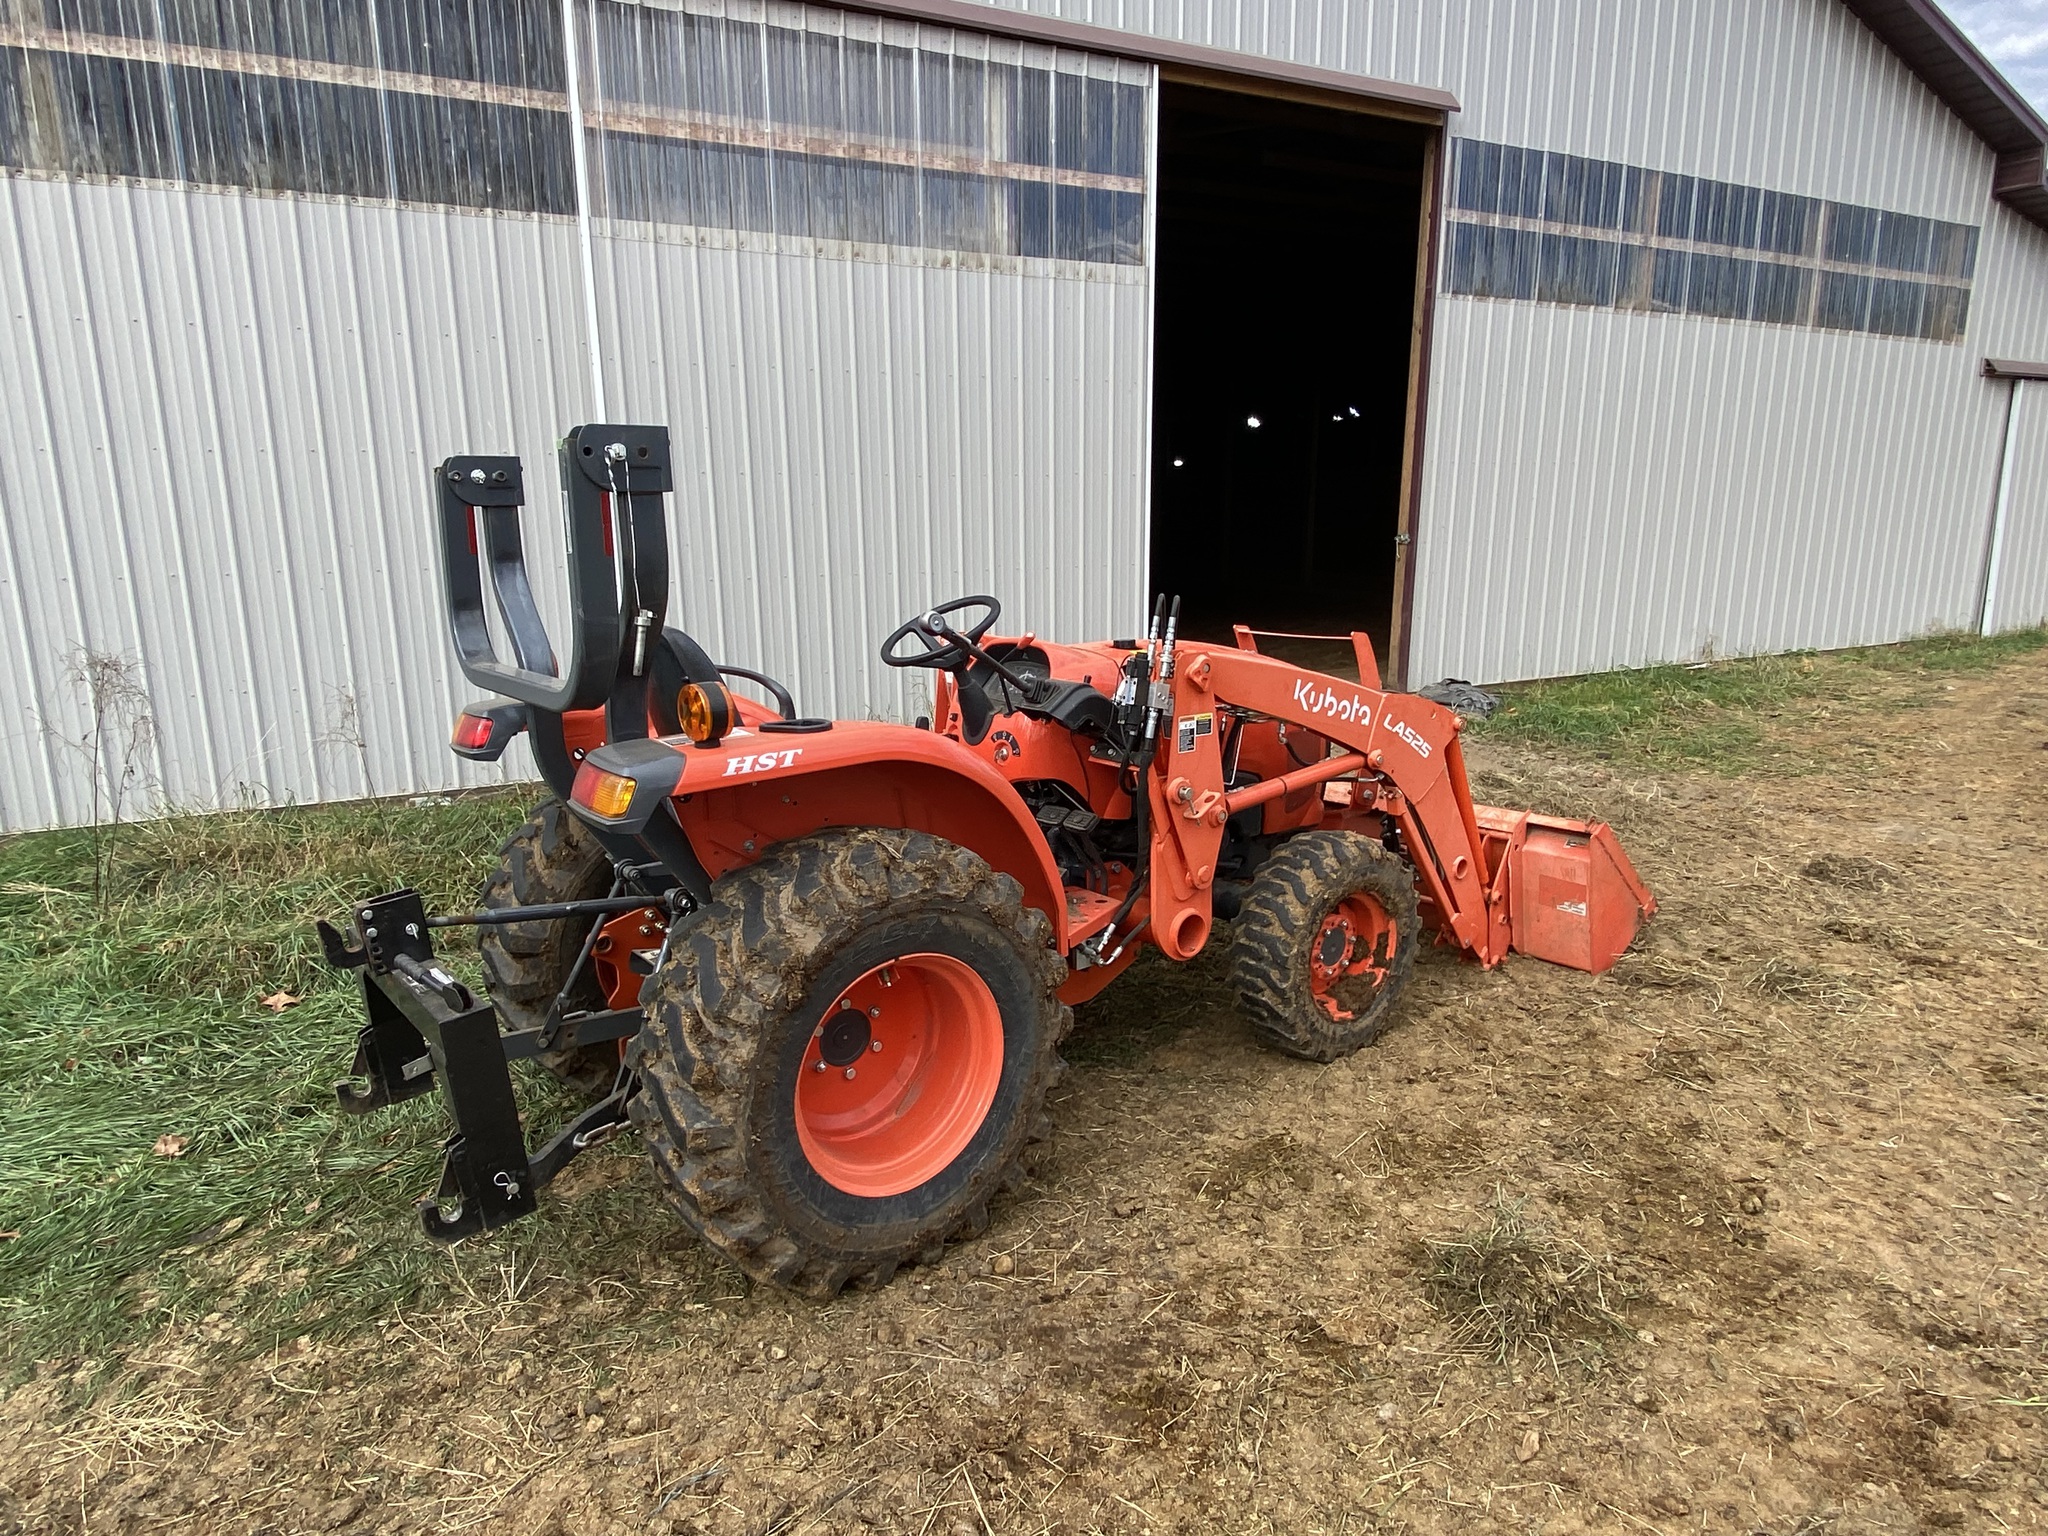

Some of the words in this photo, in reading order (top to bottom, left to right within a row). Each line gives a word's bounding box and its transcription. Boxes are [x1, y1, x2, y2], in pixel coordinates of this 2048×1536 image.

[1293, 679, 1371, 726] Kubota
[1383, 713, 1432, 759] LA525
[721, 748, 803, 777] HST
